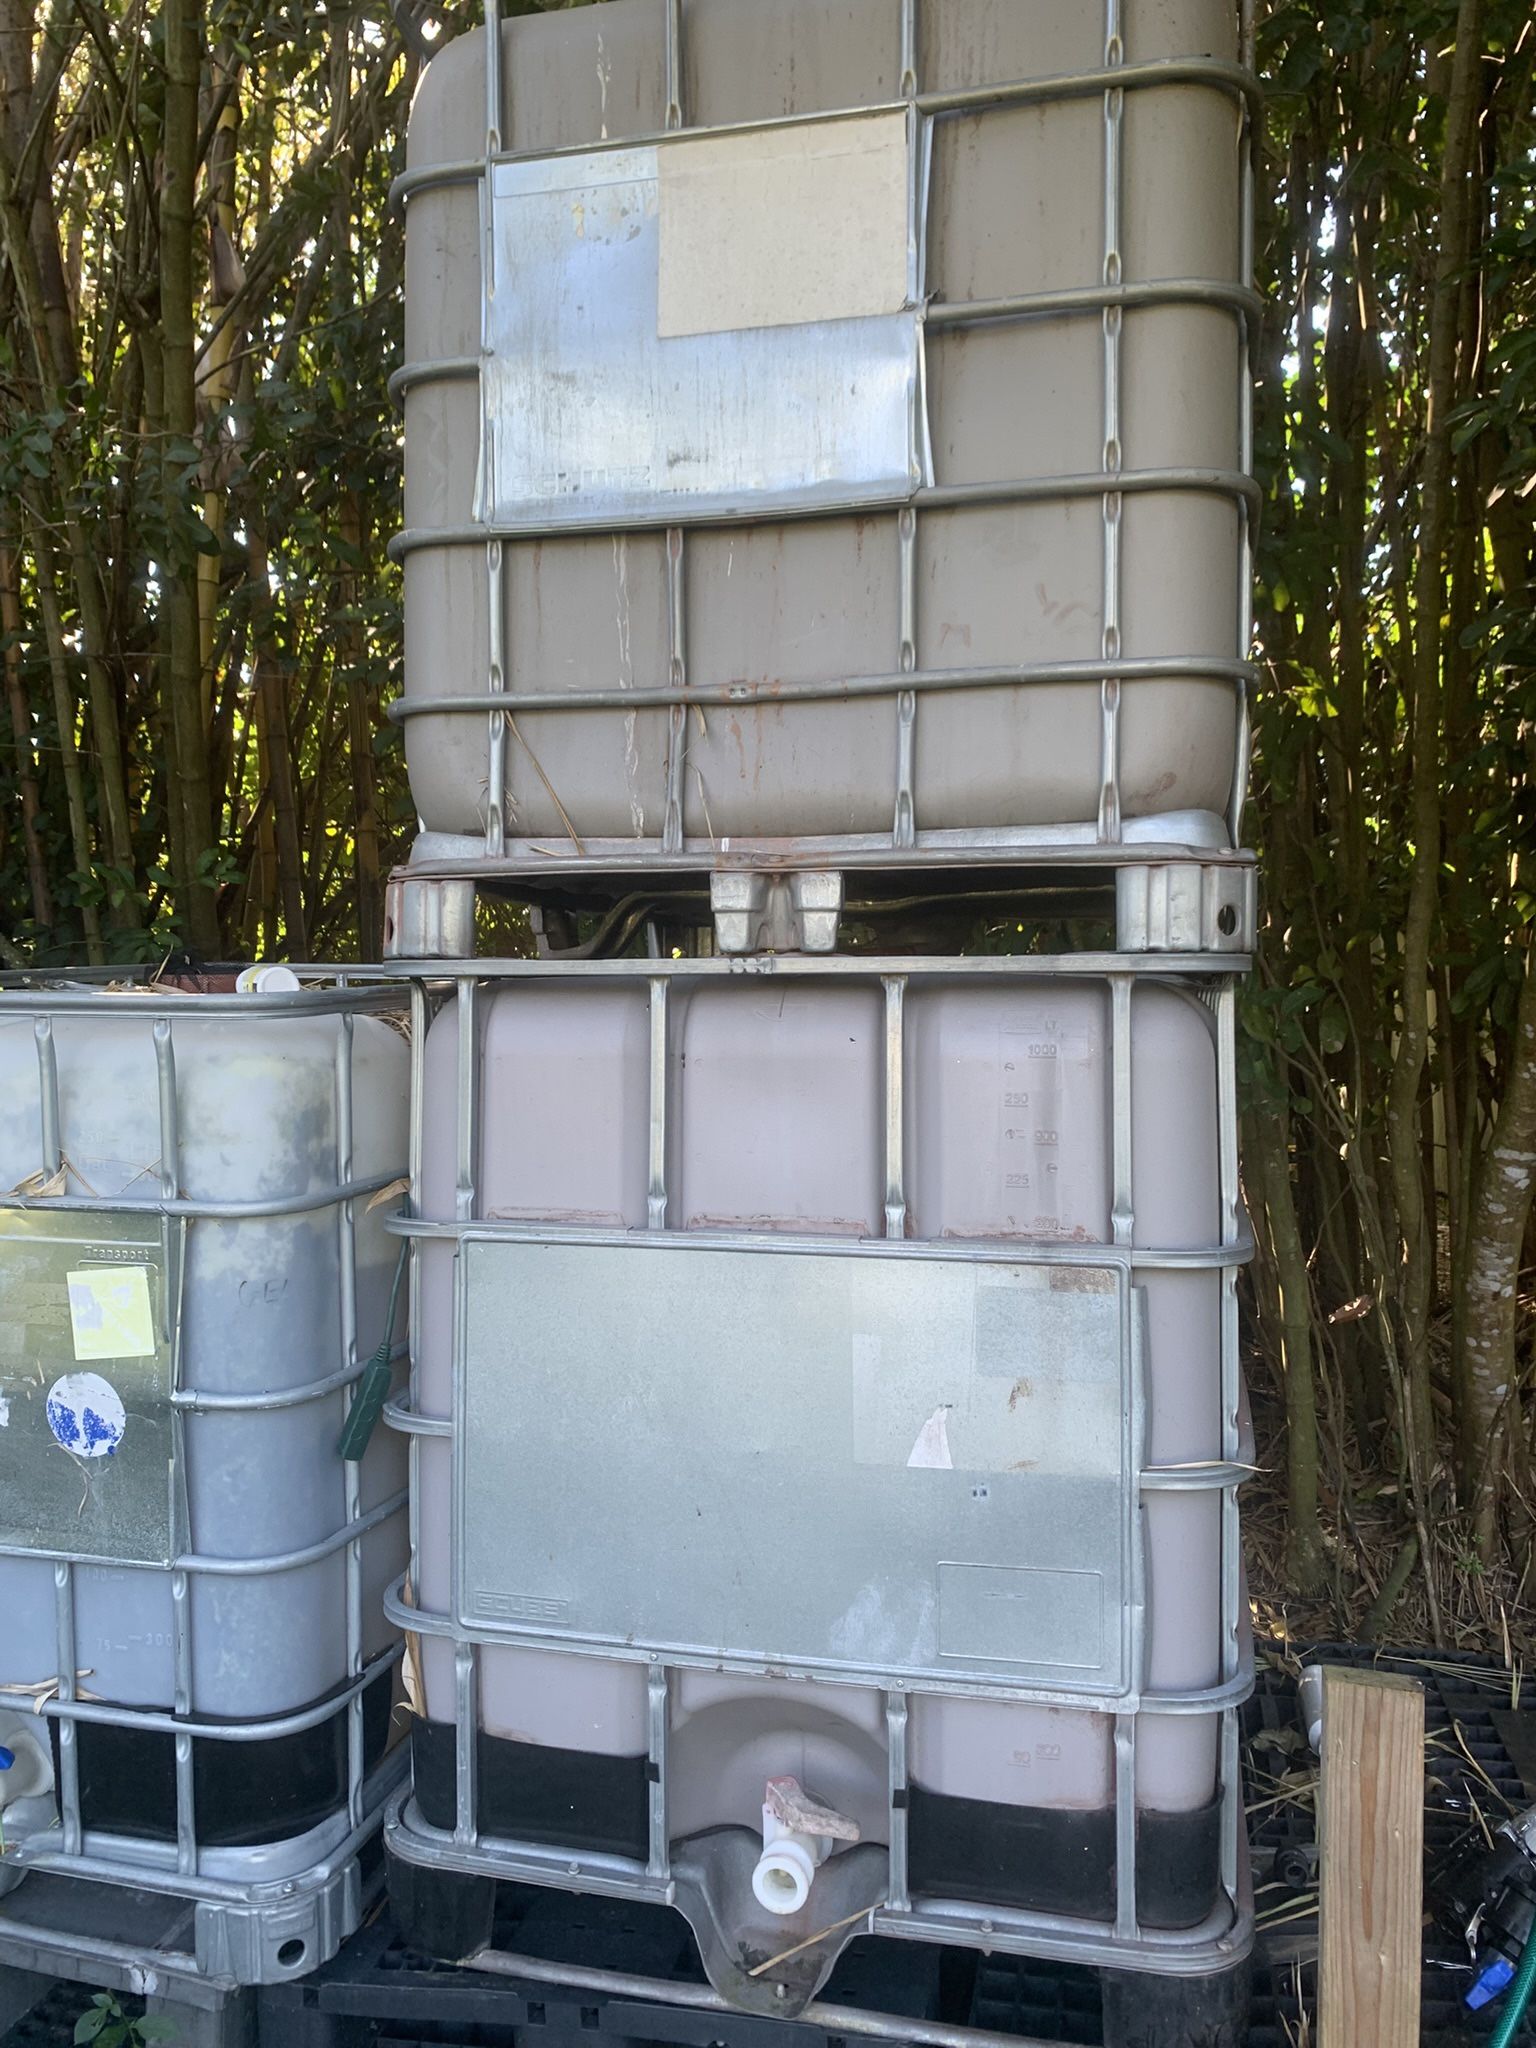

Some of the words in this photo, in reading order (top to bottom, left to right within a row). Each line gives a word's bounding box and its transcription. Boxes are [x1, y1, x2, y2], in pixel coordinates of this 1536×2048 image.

[1027, 1043, 1058, 1056] 1000
[1004, 1092, 1029, 1105] 250
[1034, 1129, 1058, 1142] 900
[1005, 1173, 1030, 1185] 225
[84, 1245, 150, 1261] Transport
[143, 1632, 173, 1647] 300
